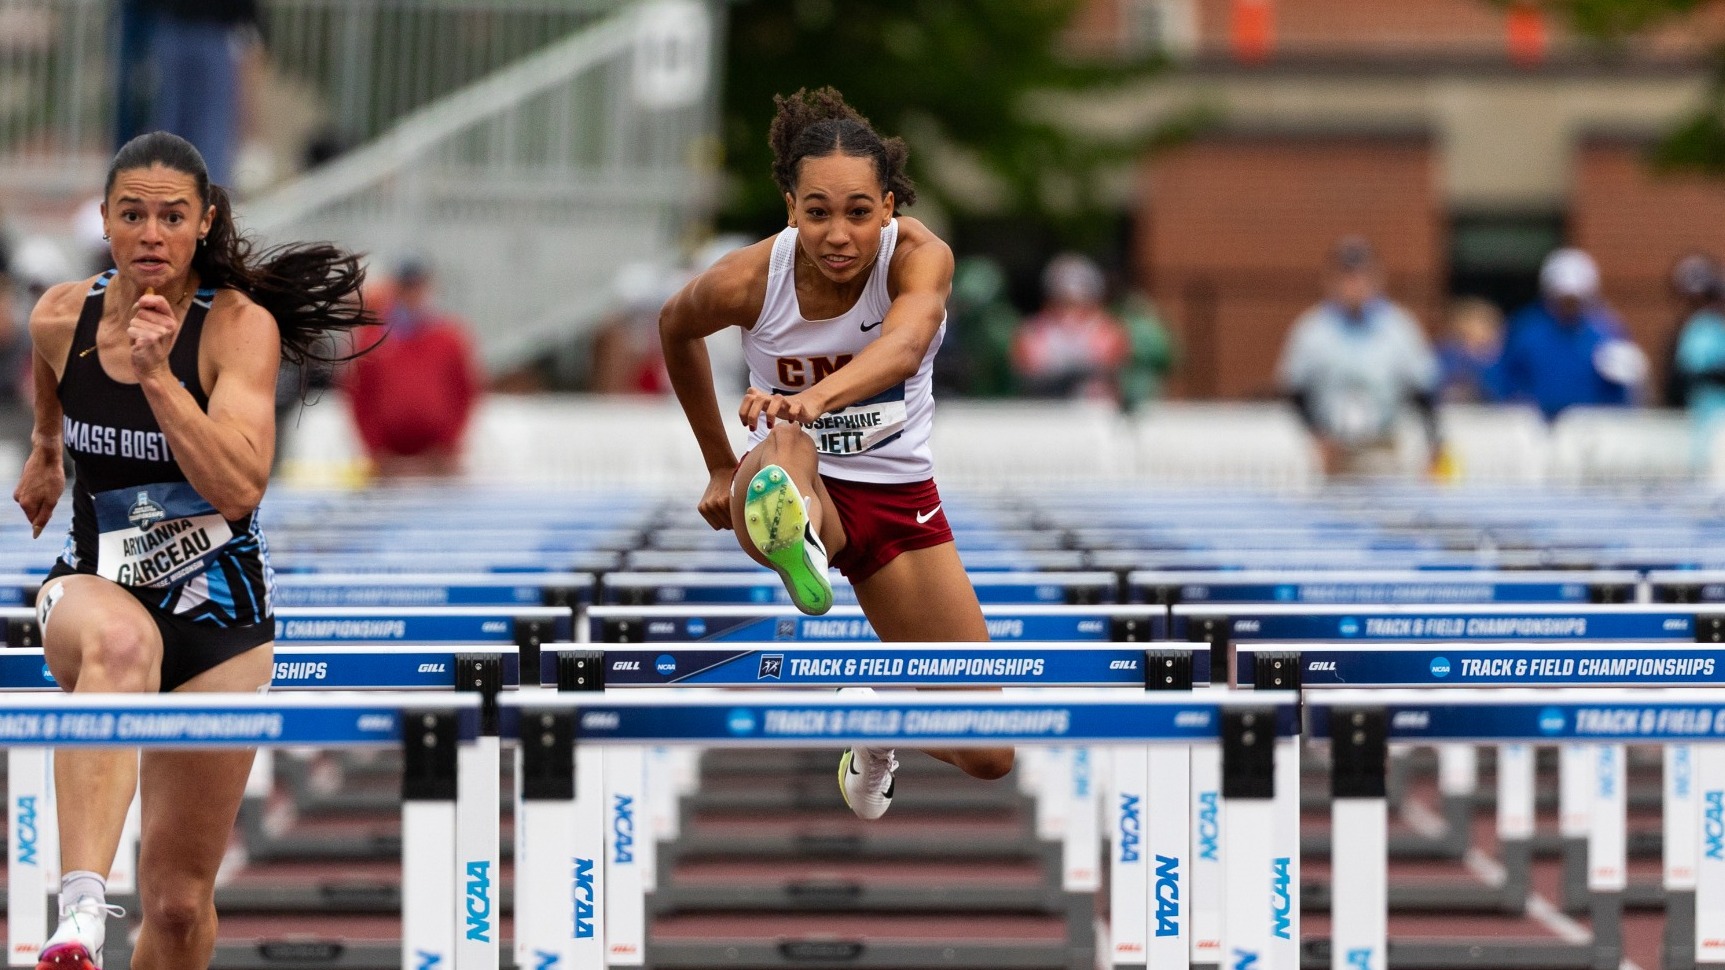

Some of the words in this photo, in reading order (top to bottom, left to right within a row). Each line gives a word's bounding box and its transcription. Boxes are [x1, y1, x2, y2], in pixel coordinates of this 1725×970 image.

[777, 354, 853, 387] CM
[800, 412, 882, 430] OSEPHINE
[121, 429, 169, 462] BOST
[816, 432, 863, 453] JETT
[123, 519, 193, 557] ARYIANNA
[117, 528, 211, 587] GARCEAU
[284, 620, 405, 638] CHAMPIONSHIPS
[1366, 617, 1410, 635] TRACK
[1467, 617, 1587, 636] CHAMPIONSHIPS
[418, 663, 446, 673] GILL
[612, 661, 640, 671] GILL
[790, 658, 842, 676] TRACK
[844, 659, 857, 676] &
[859, 659, 904, 676] FIELD
[907, 658, 1045, 676] CHAMPIONSHIPS
[1109, 660, 1137, 670] GILL
[1308, 661, 1336, 671] GILL
[1461, 659, 1514, 677] TRACK
[1515, 659, 1528, 677] &
[1530, 659, 1575, 677] FIELD
[1577, 658, 1716, 677] CHAMPIONSHIPS
[0, 713, 40, 737] ACK
[17, 796, 37, 865] NCAA
[614, 794, 633, 864] NCAA
[1120, 793, 1140, 863] NCAA
[1199, 791, 1218, 861] NCAA
[1705, 791, 1724, 860] NCAA
[466, 860, 490, 943] NCAA
[573, 857, 594, 939] NCAA
[1155, 854, 1179, 937] NCAA
[1270, 857, 1291, 940] NCAA
